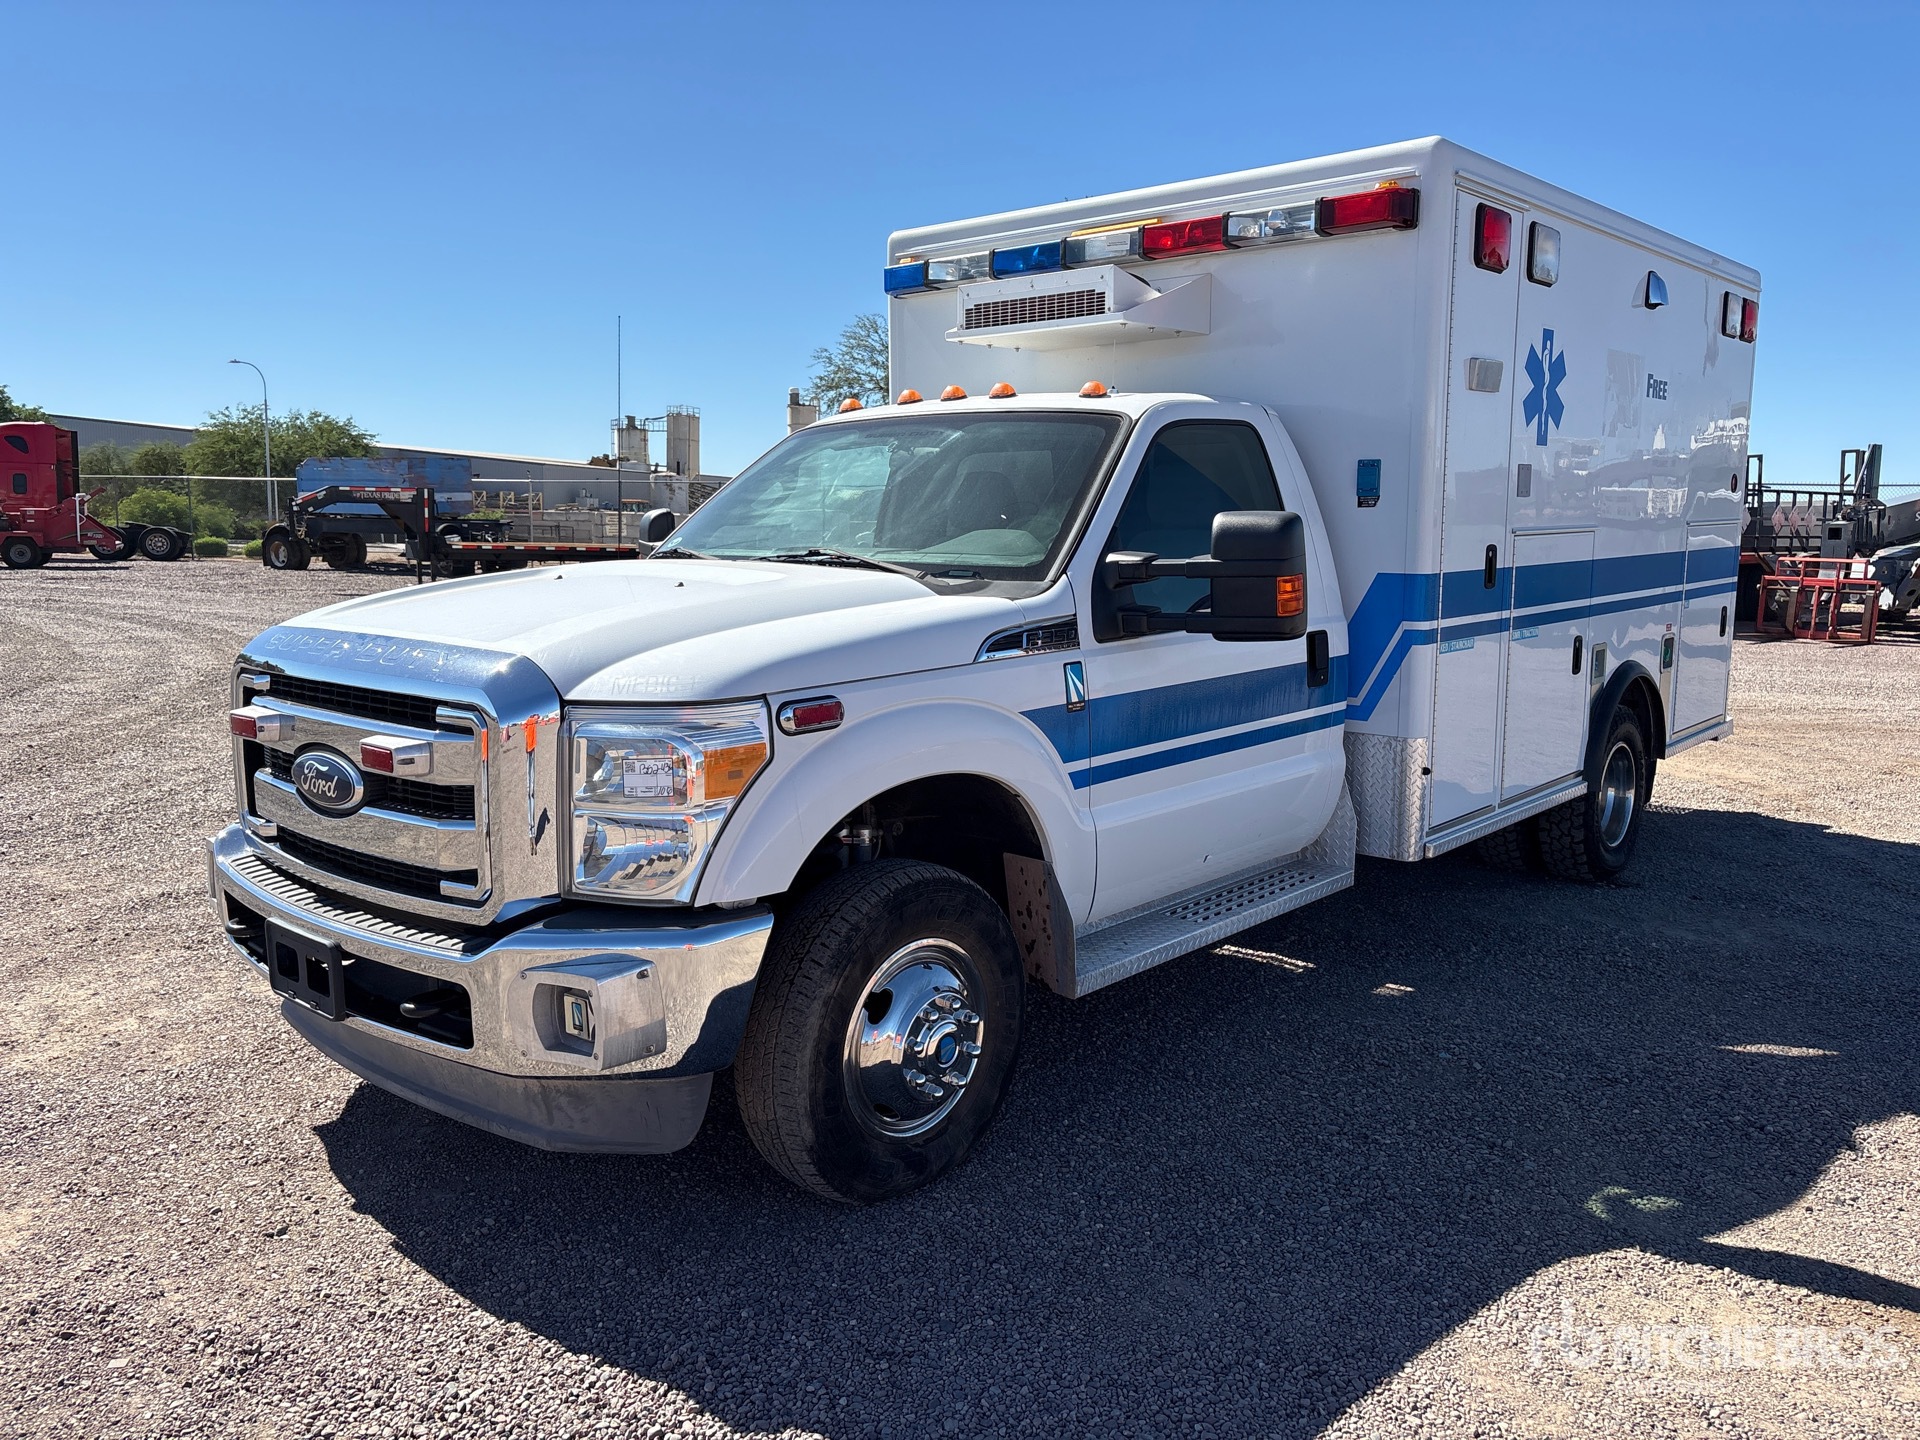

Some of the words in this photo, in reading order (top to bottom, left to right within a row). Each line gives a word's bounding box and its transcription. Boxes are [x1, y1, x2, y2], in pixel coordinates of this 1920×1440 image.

[360, 491, 380, 499] TEXAS
[381, 491, 401, 500] PRIDE
[265, 633, 349, 660] SUPER
[354, 641, 464, 673] DUTY
[301, 760, 339, 798] Ford
